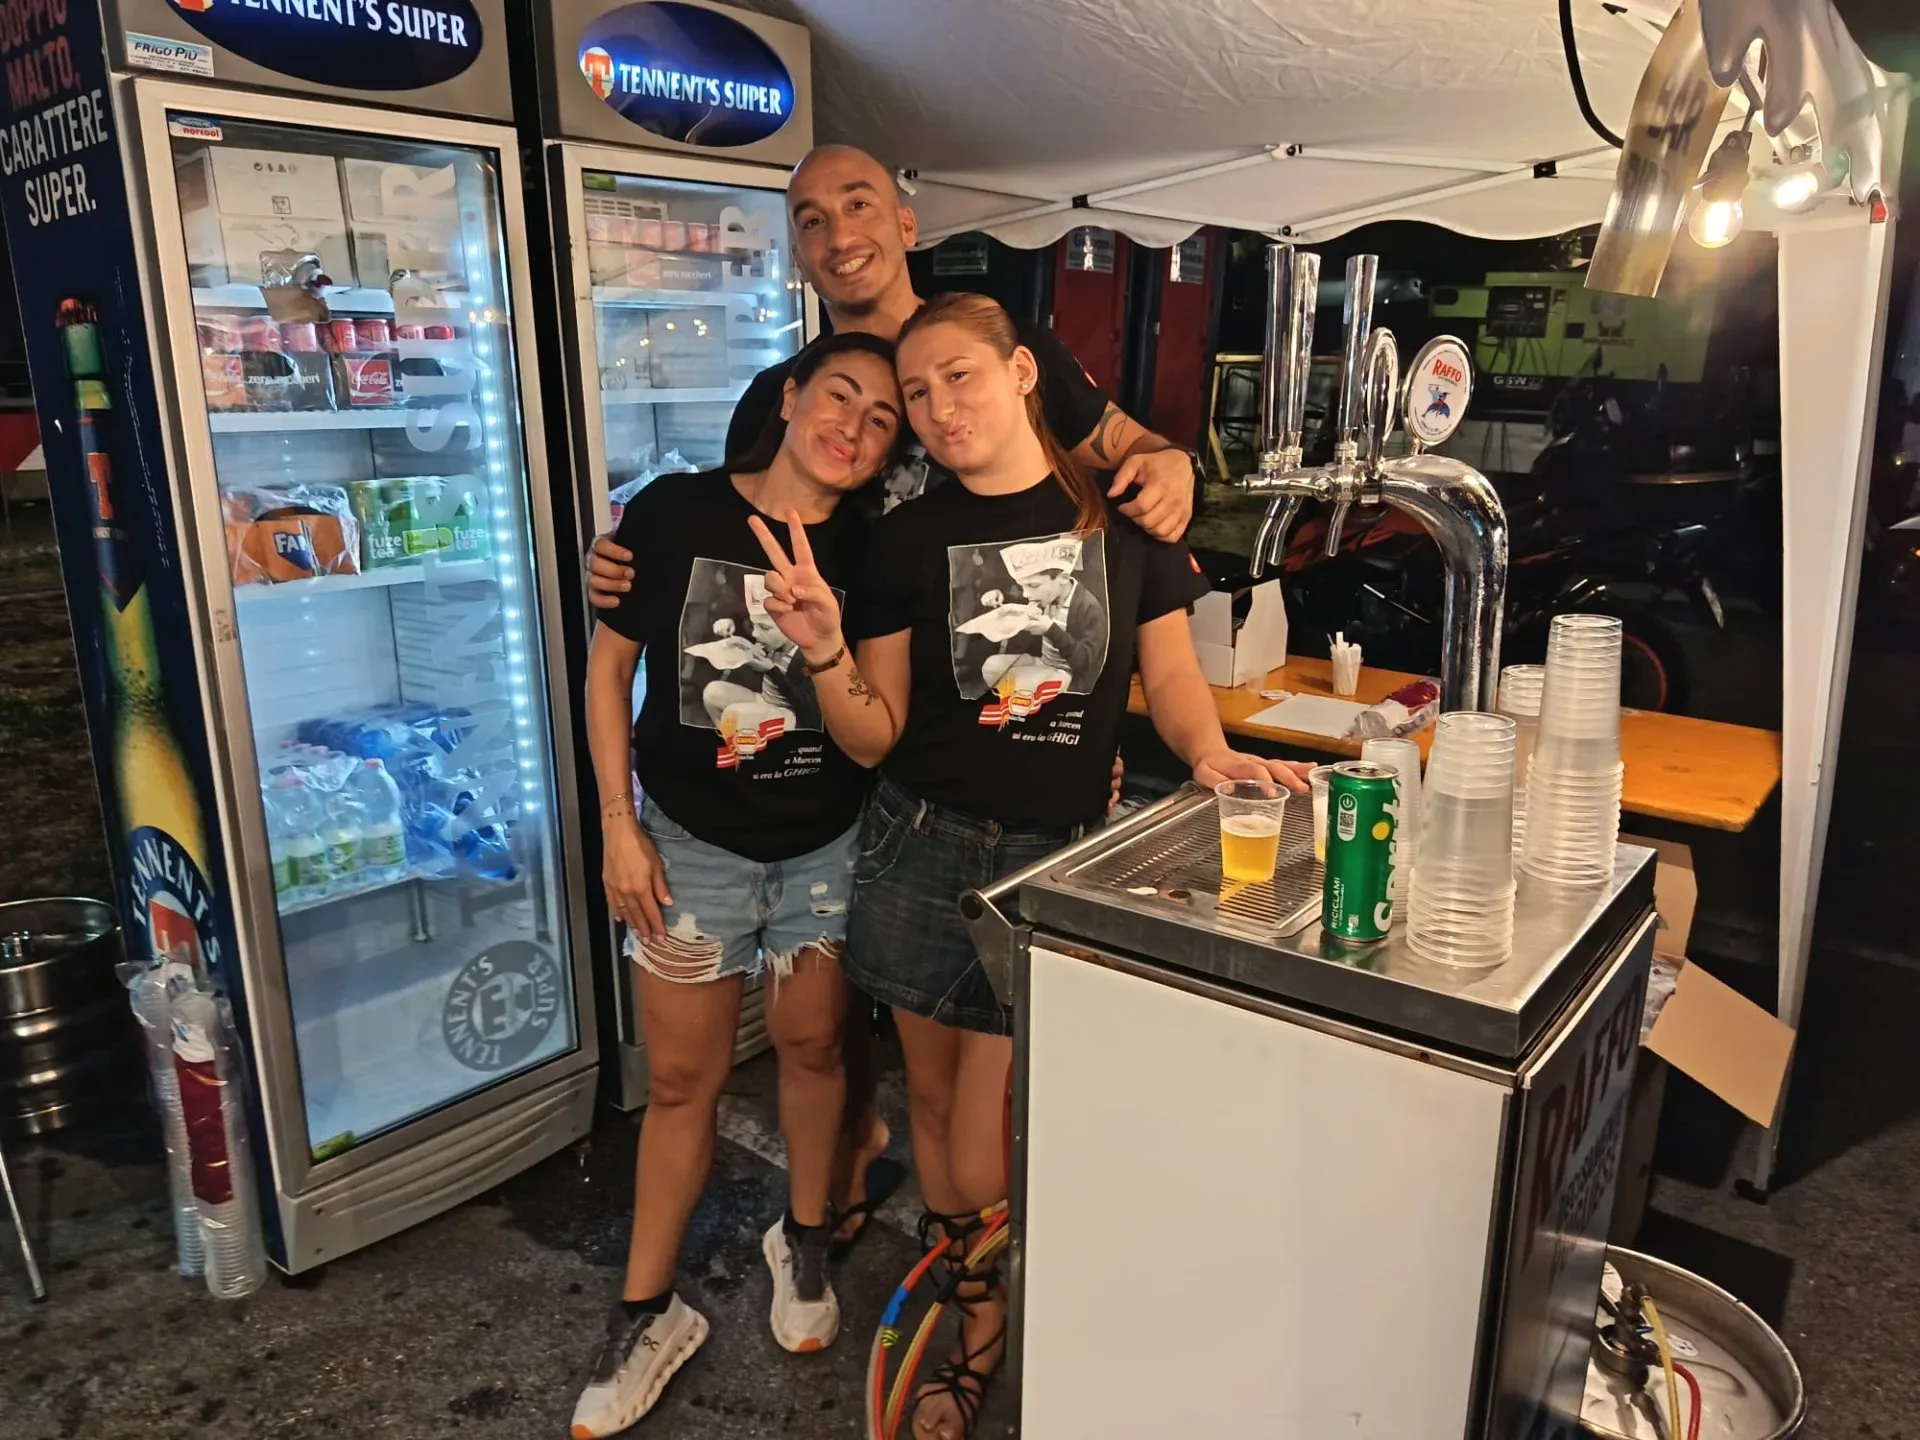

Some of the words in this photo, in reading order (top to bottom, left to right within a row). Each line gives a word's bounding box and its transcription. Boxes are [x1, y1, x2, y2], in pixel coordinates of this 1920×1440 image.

[230, 0, 382, 31] NENT'S
[386, 2, 469, 47] SUPER
[619, 63, 721, 106] TENNENT'S
[723, 80, 783, 116] SUPER
[0, 89, 109, 176] CARATTERE
[183, 127, 220, 138] norcool
[25, 163, 97, 227] SUPER.
[1432, 358, 1462, 383] RAFFO
[367, 532, 402, 550] fuze
[453, 525, 485, 542] fuze
[455, 538, 479, 551] tea
[131, 837, 222, 963] TENNENT'S
[1330, 876, 1341, 929] RICICLAMI
[448, 955, 501, 1065] TENNENT'S
[528, 952, 557, 1030] SUPER
[1520, 974, 1643, 1273] RAFFO
